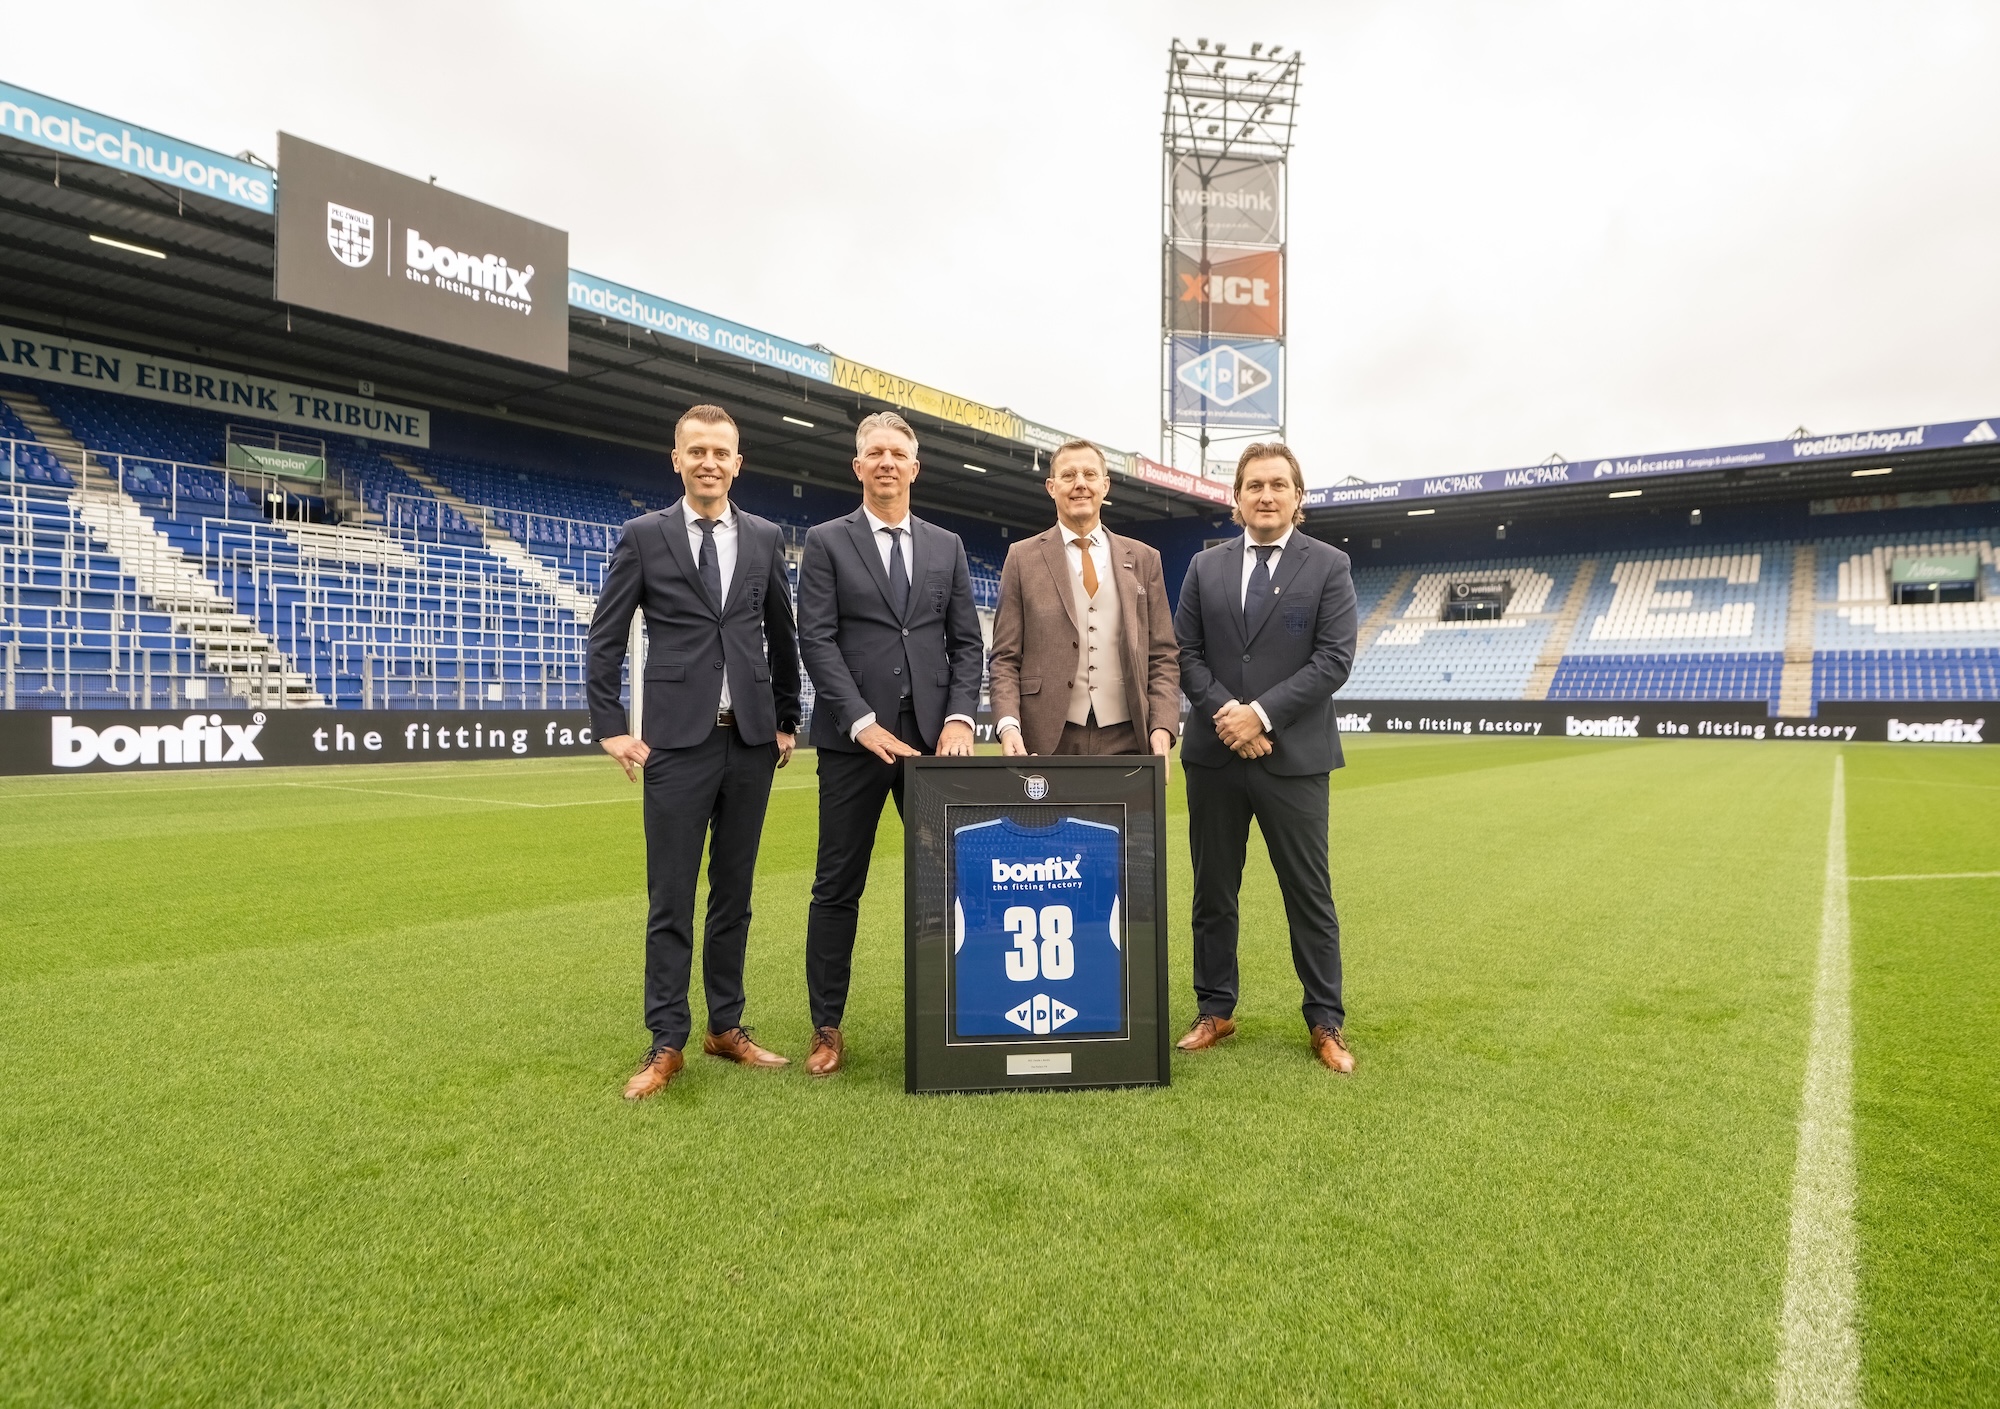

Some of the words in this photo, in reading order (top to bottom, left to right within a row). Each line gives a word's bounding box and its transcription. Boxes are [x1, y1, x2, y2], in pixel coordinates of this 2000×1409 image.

[0, 101, 269, 205] matchworks
[1176, 188, 1272, 211] wensink
[406, 268, 430, 284] the
[435, 276, 480, 301] fitting
[485, 290, 532, 315] factory
[568, 281, 710, 341] matchworks
[715, 328, 830, 378] matchworks
[363, 382, 370, 393] 3
[1195, 366, 1255, 385] VDK
[136, 363, 279, 412] EIBRINK
[289, 393, 420, 438] TRIBUNE
[1793, 426, 1924, 457] voetbalshop.nl
[1615, 457, 1684, 475] Molecaten
[1145, 464, 1194, 492] Bouwbedrijf
[1195, 480, 1225, 500] Bongers
[1332, 482, 1401, 501] zonneplan
[1471, 584, 1503, 594] wensink
[313, 723, 383, 752] the
[404, 721, 528, 754] fitting
[1336, 712, 1373, 732] nfix
[1386, 717, 1412, 731] the
[1418, 717, 1472, 735] fitting
[1478, 718, 1542, 736] factory
[1656, 720, 1689, 735] the
[1697, 720, 1766, 740] fitting
[1774, 721, 1857, 741] factory
[1012, 882, 1044, 891] fitting
[1048, 881, 1083, 890] factory
[1003, 905, 1075, 982] 38
[1016, 1008, 1067, 1022] VDK
